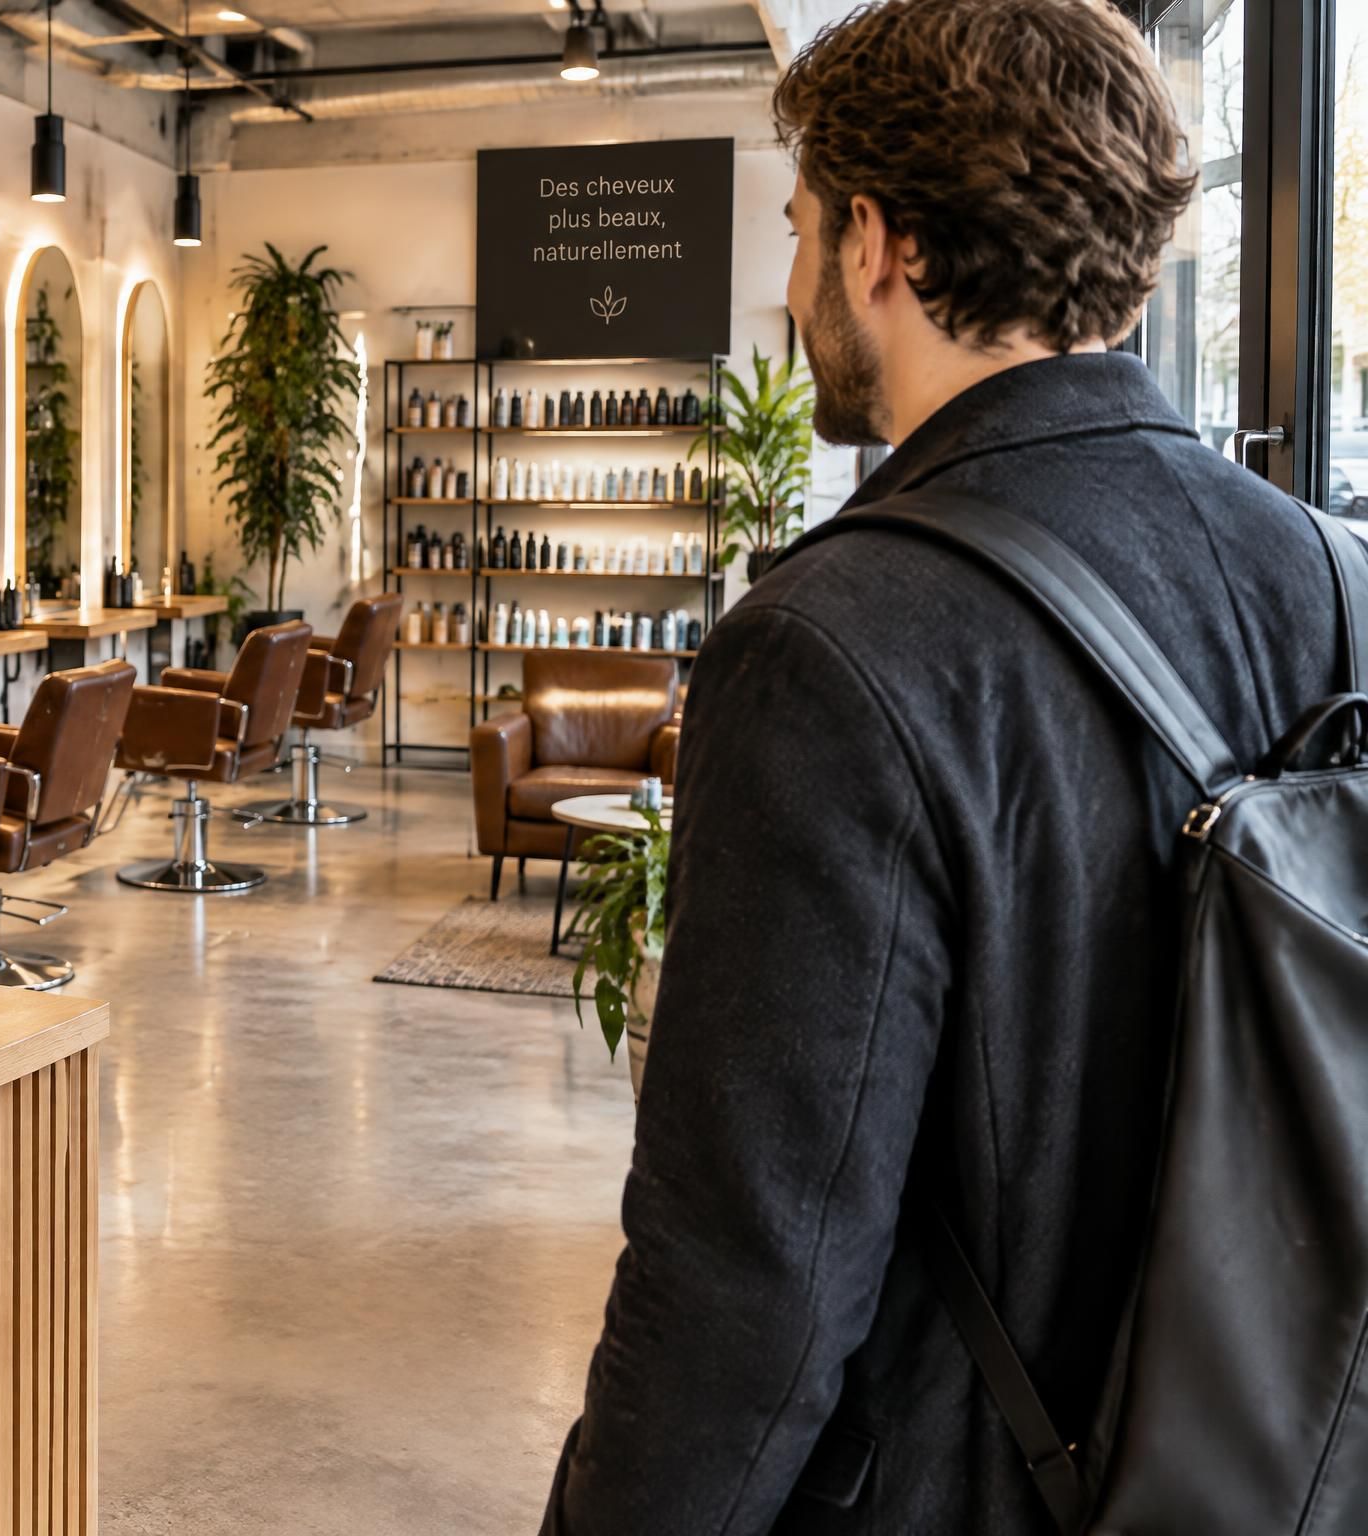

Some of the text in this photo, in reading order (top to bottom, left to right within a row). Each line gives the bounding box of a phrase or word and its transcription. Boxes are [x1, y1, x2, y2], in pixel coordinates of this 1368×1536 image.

[539, 176, 675, 198] Des cheveux
[548, 207, 666, 233] plus beaux,
[533, 240, 683, 262] naturellement
